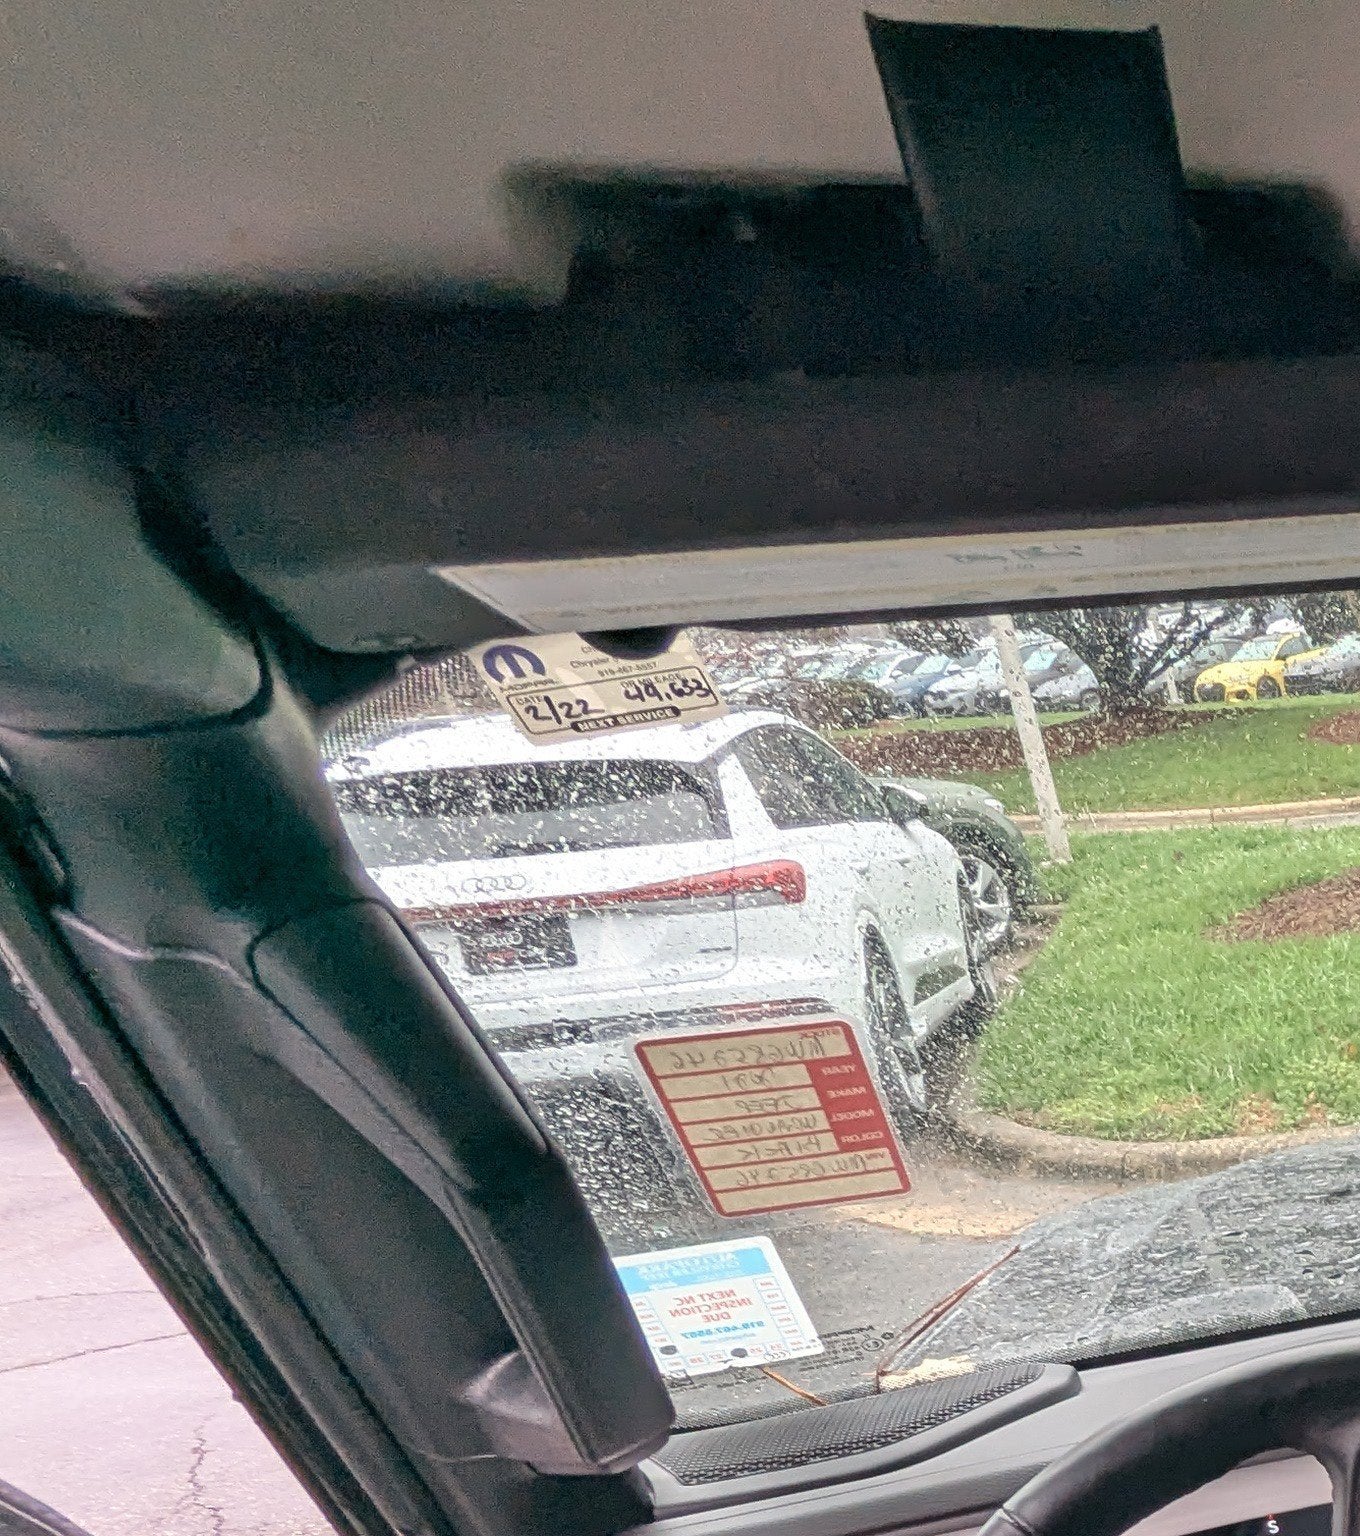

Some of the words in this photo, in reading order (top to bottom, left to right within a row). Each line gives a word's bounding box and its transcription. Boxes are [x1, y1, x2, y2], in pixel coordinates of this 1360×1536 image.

[578, 716, 616, 732] NEXT
[618, 706, 675, 725] SERVICE
[1267, 1520, 1279, 1534] S
